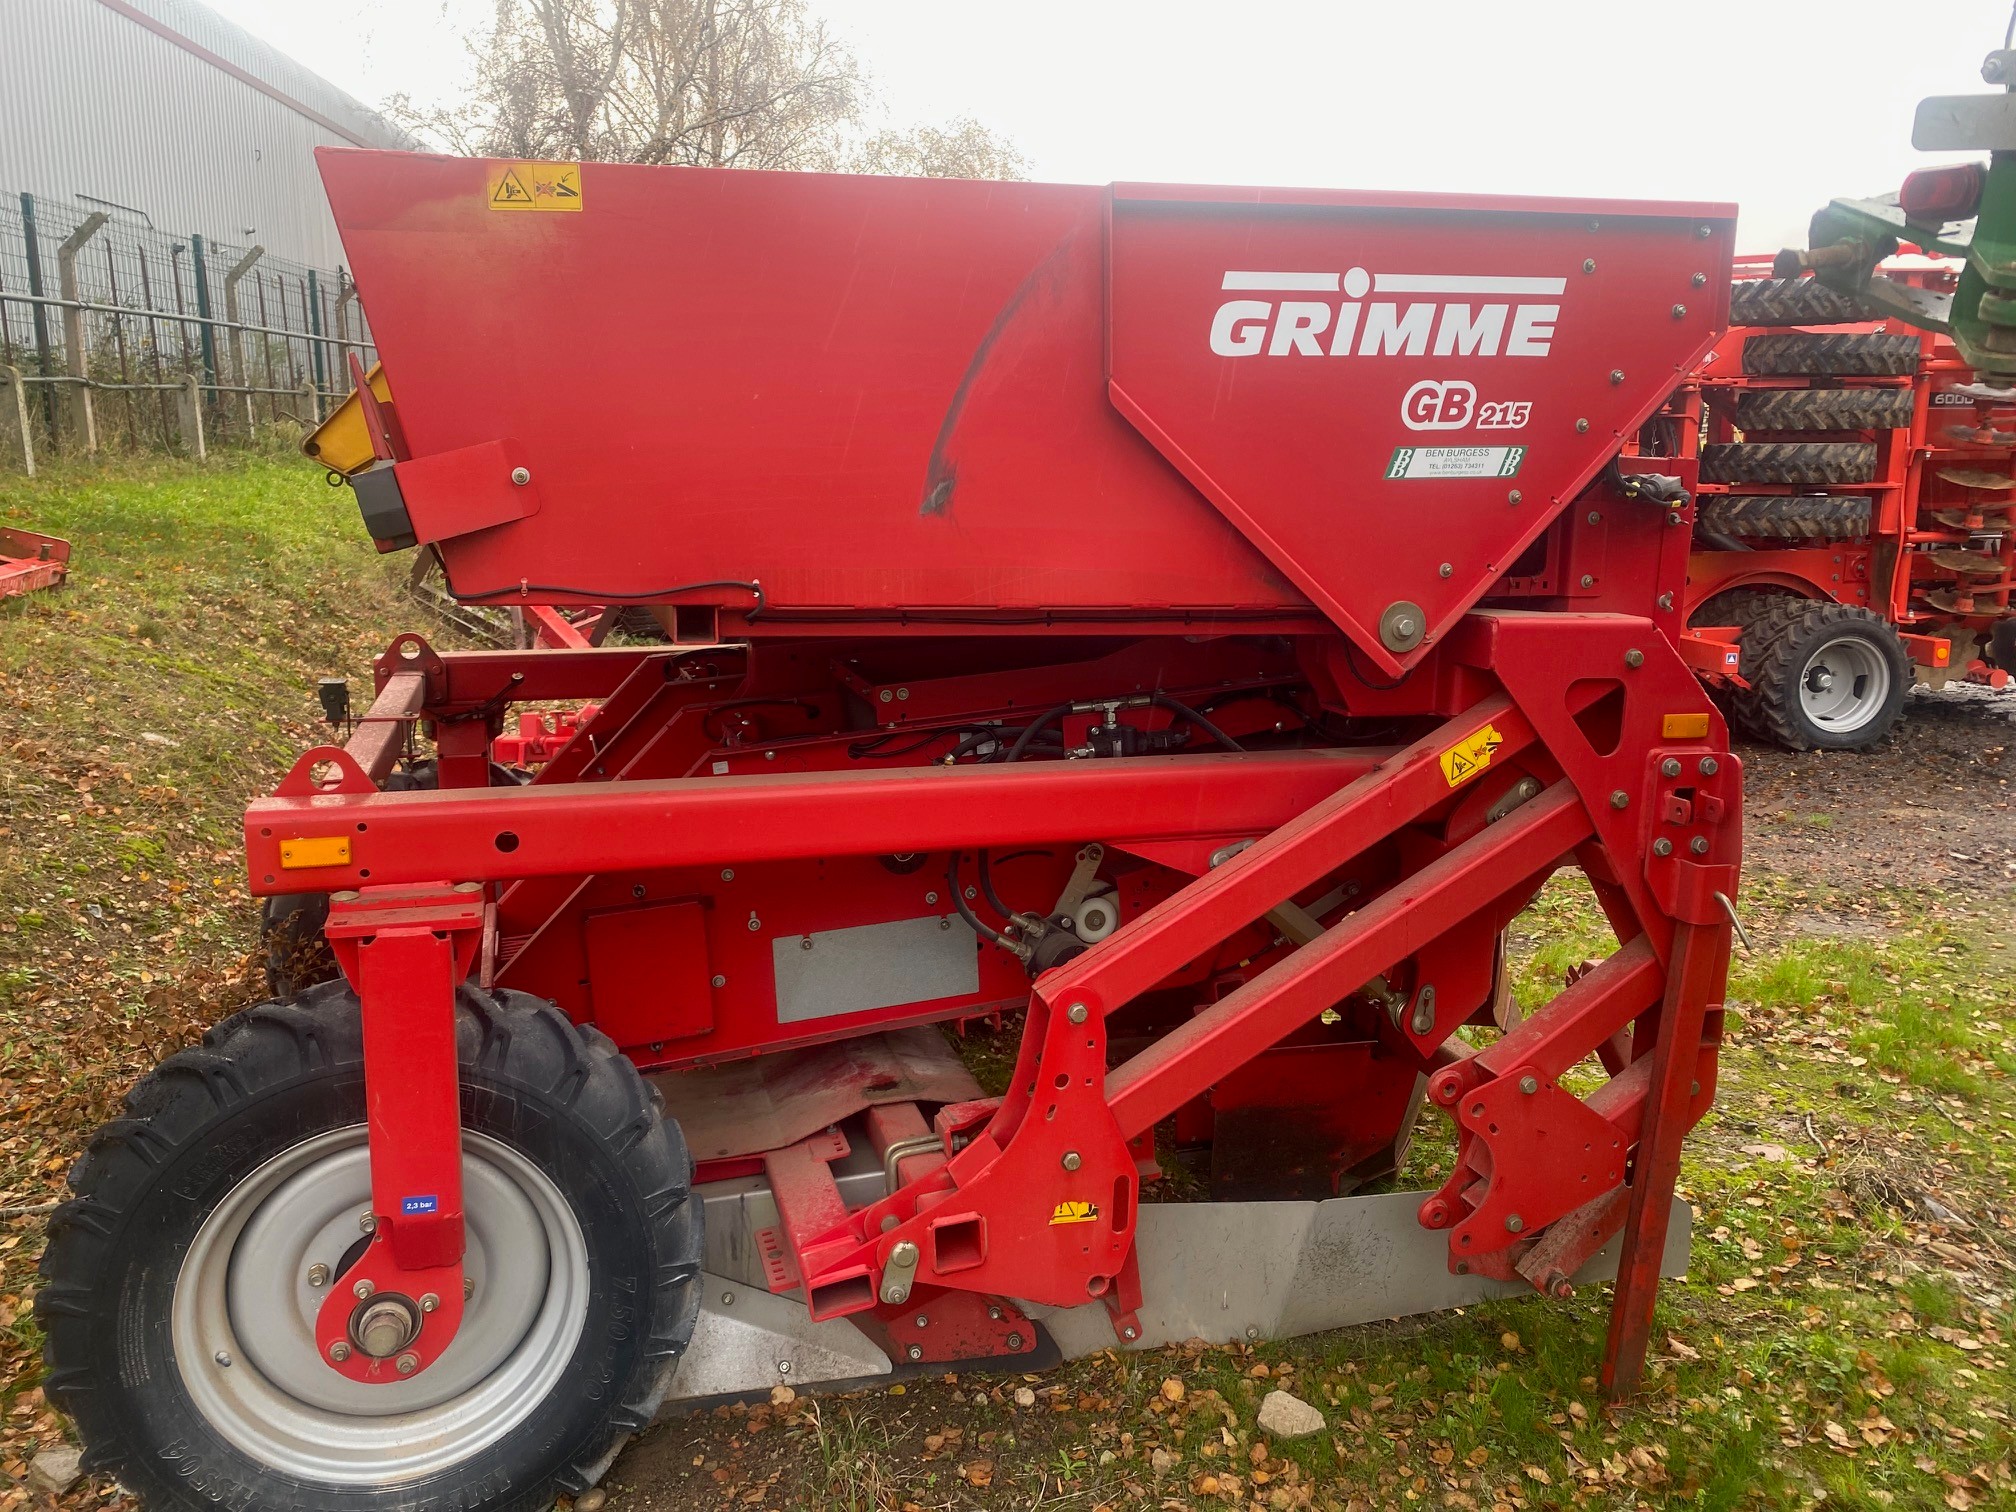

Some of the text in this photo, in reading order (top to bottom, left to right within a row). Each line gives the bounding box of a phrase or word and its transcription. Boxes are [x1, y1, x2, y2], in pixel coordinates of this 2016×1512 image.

[1208, 267, 1562, 358] GRIMME
[1401, 381, 1533, 430] GB 215
[1425, 448, 1490, 458] BEN BURGESS
[406, 1201, 433, 1210] 2,3 bar
